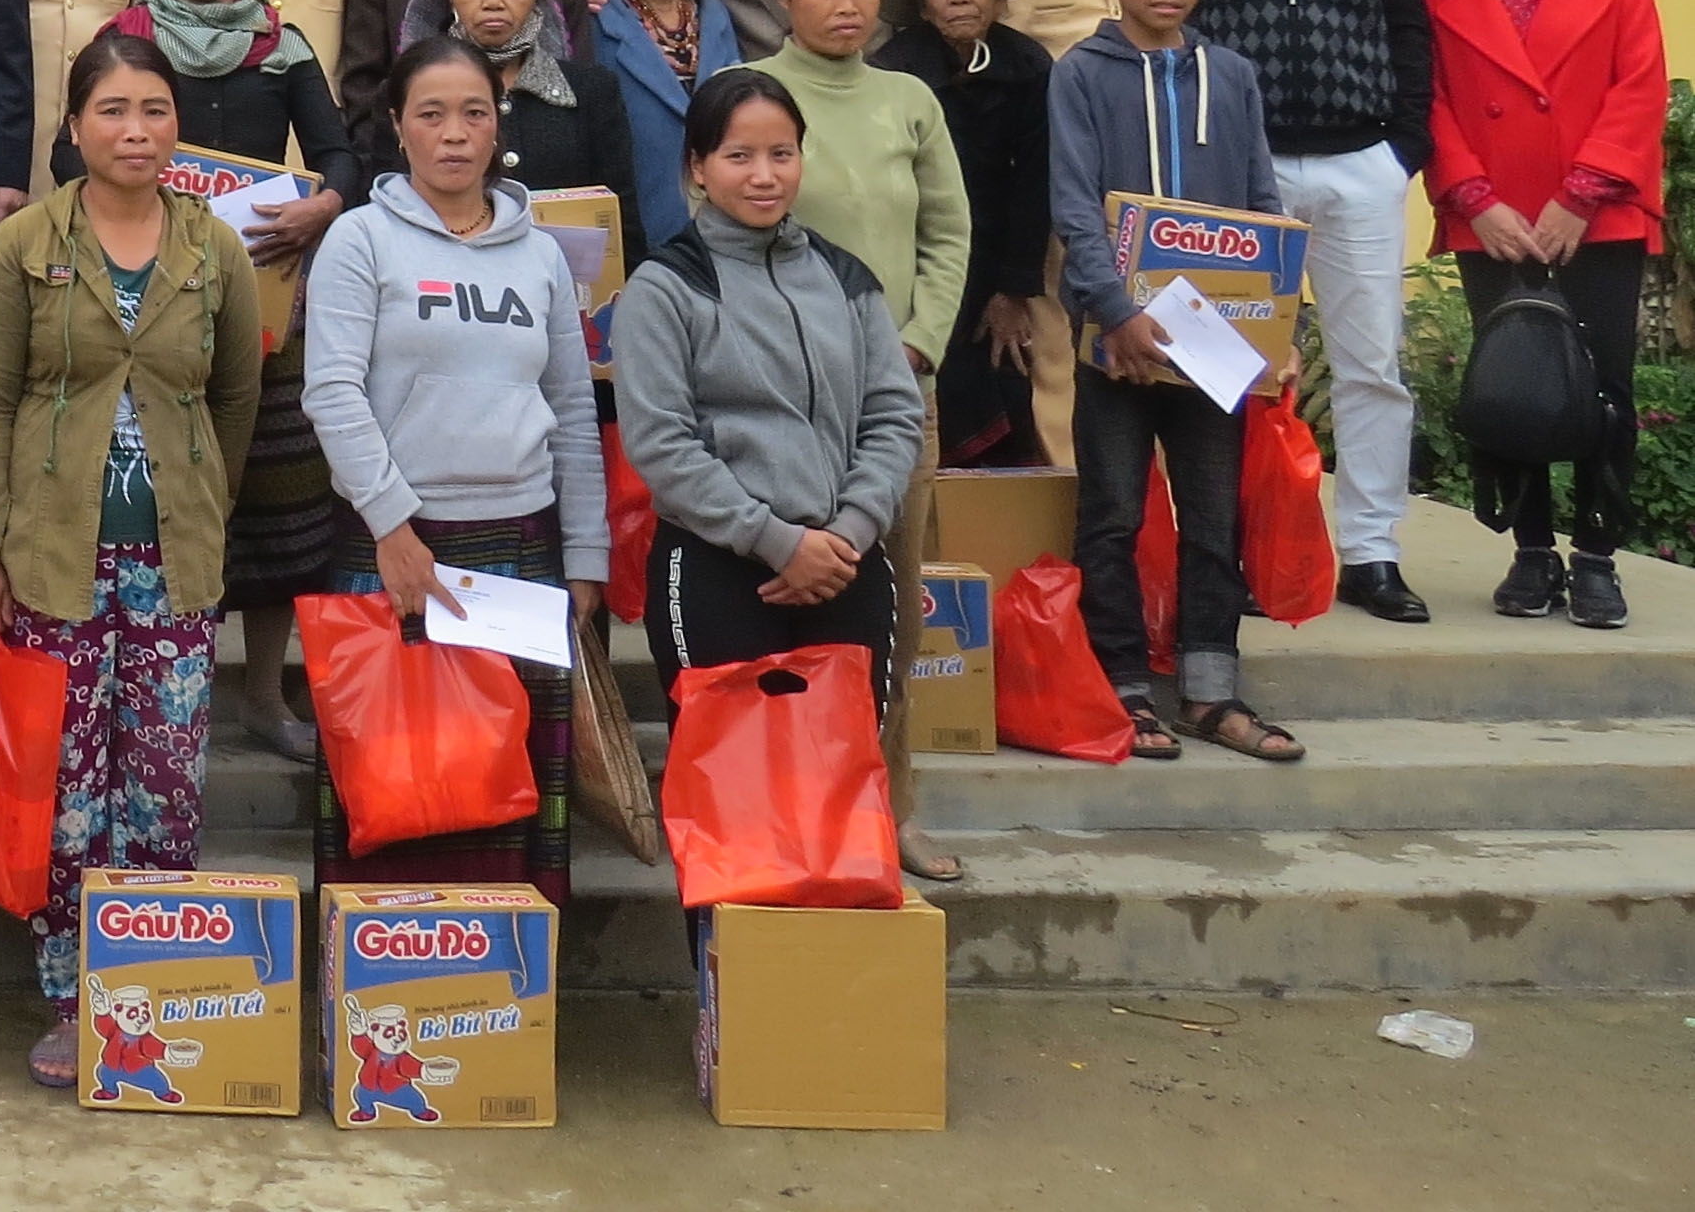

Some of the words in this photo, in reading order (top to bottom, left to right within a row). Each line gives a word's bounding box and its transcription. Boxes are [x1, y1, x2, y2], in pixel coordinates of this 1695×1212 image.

[1150, 217, 1217, 255] Gấu
[1215, 223, 1260, 261] Đỏ
[418, 280, 534, 328] FILA
[97, 900, 178, 941] Gấu
[179, 902, 234, 944] Đỏ
[354, 919, 436, 960] Gấu
[436, 919, 490, 960] Đỏ
[160, 996, 191, 1023] Bò
[229, 989, 266, 1018] Tết
[417, 1014, 448, 1041] Bò
[485, 1003, 522, 1032] Tết
